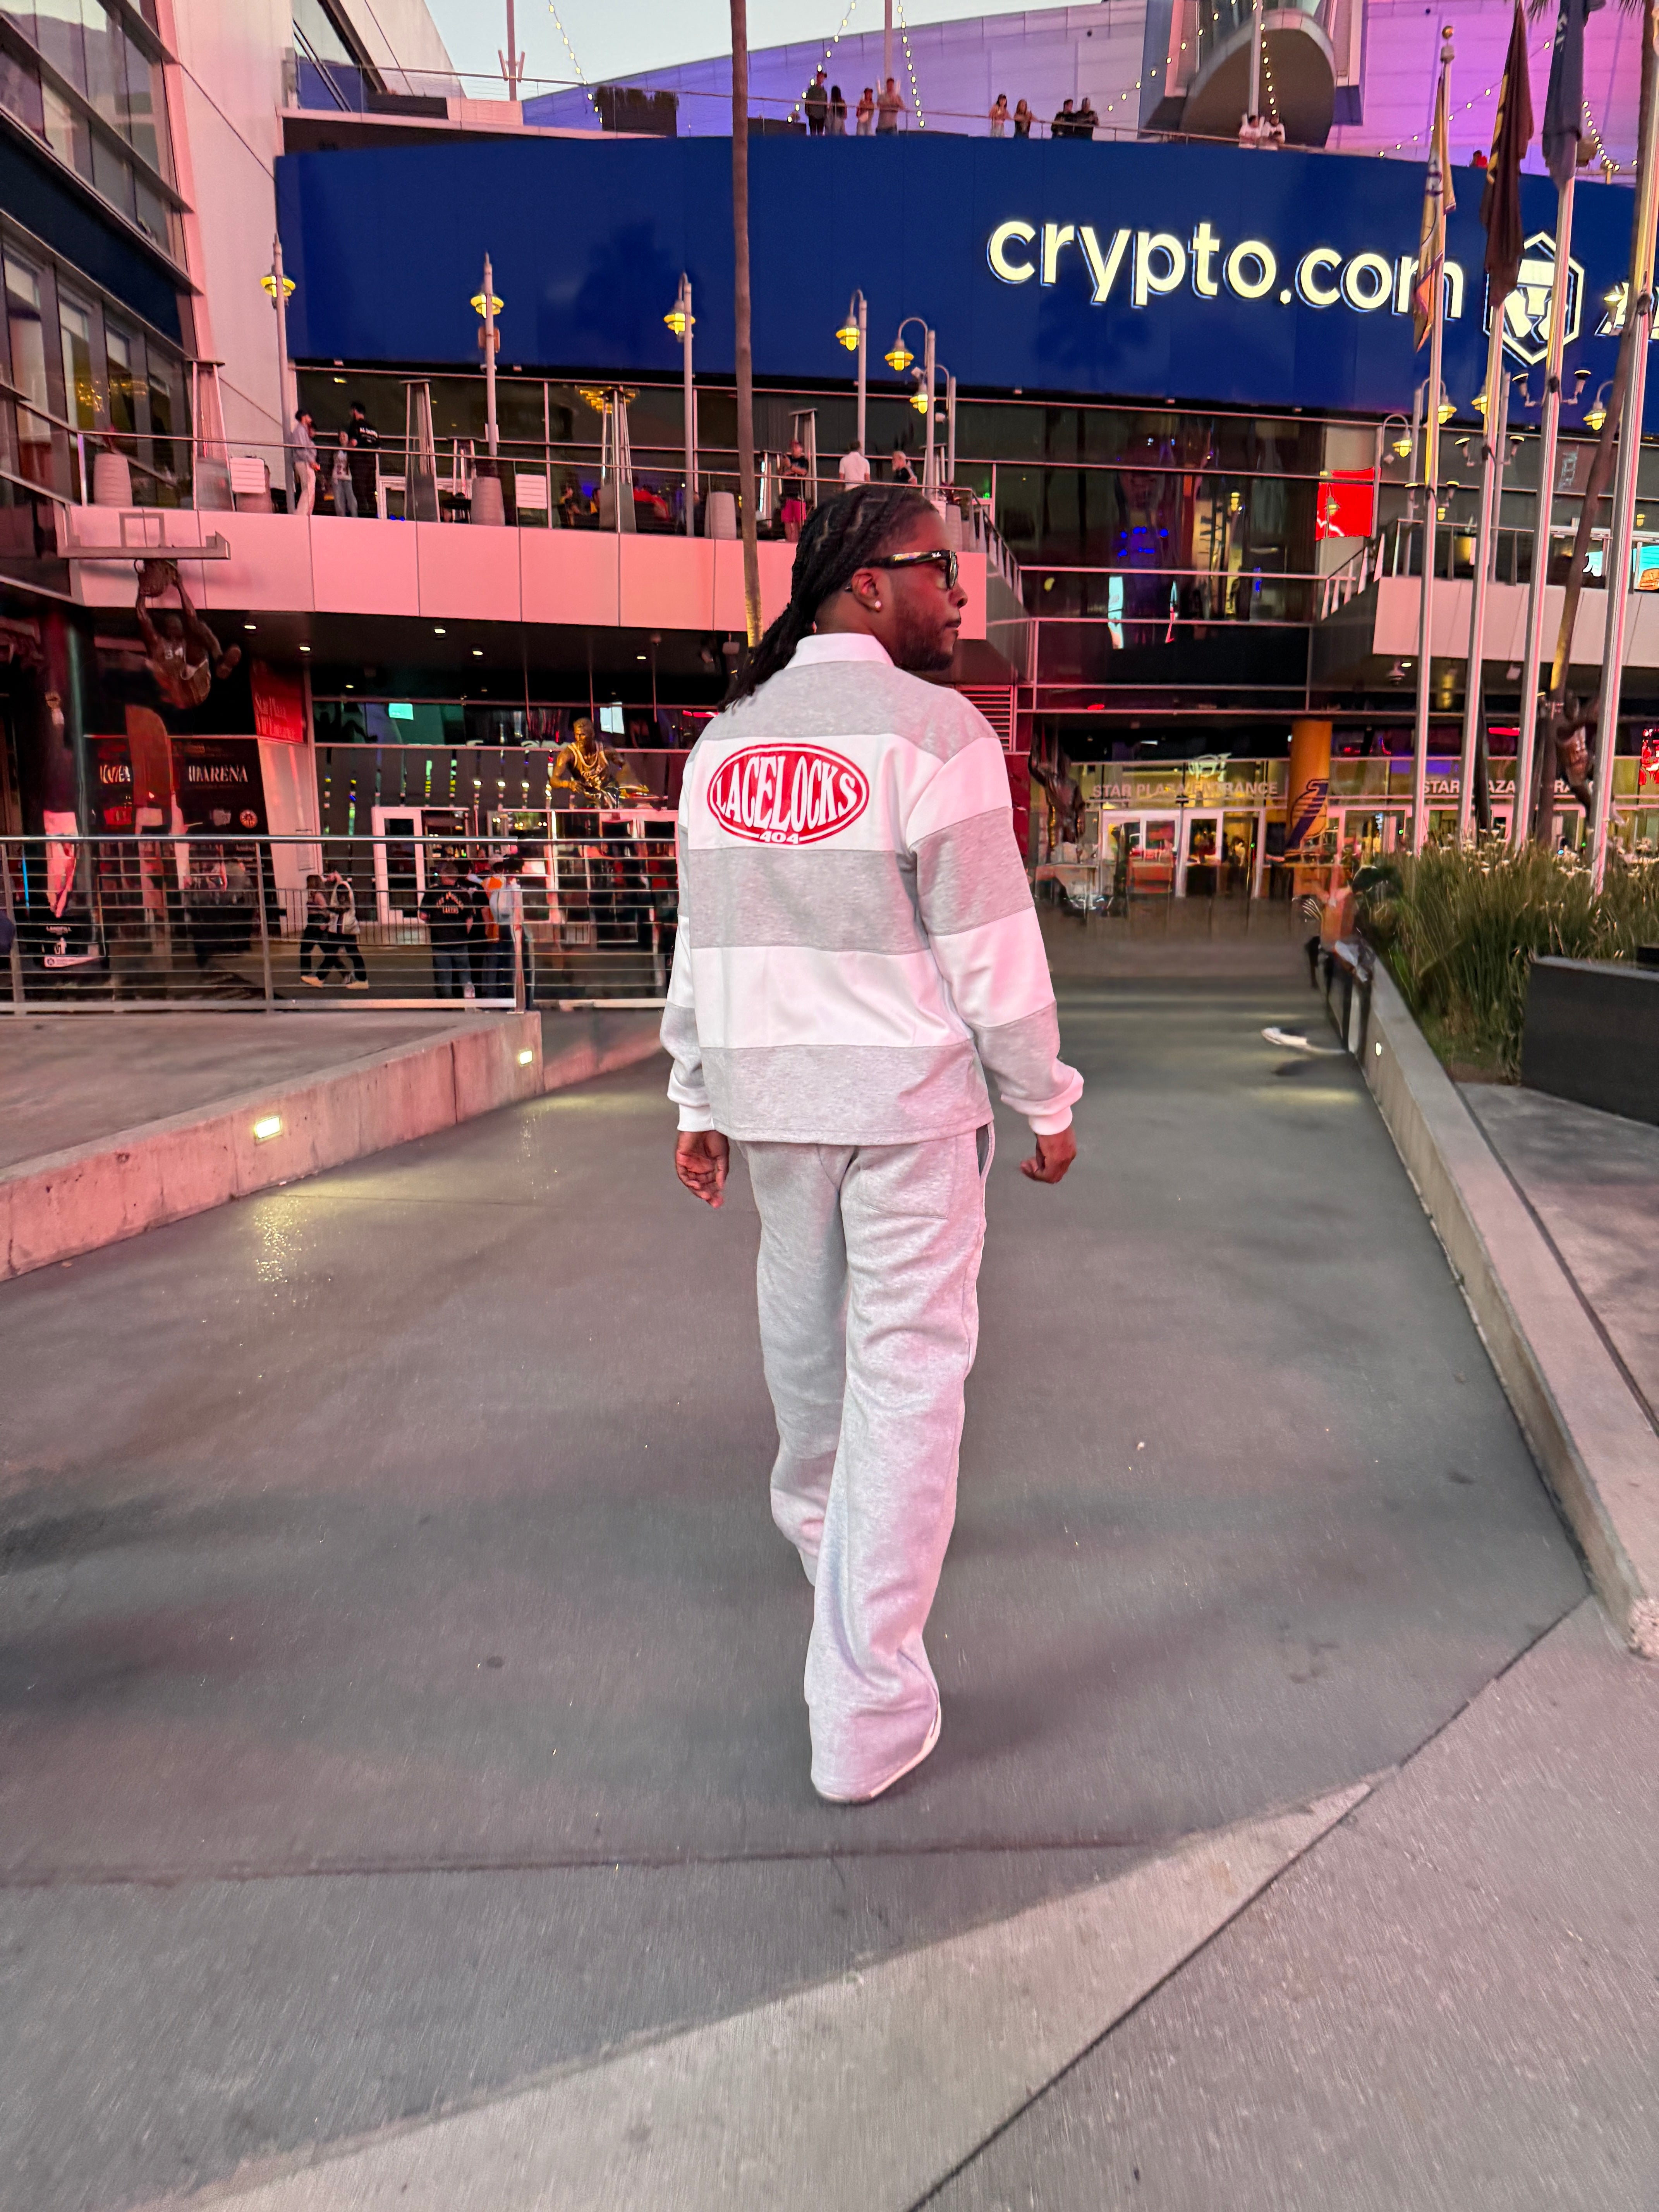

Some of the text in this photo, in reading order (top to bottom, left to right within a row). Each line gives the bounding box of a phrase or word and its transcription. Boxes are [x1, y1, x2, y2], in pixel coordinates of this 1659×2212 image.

[987, 221, 1464, 320] crypto.com
[716, 755, 857, 833] LACELOCKS
[1092, 783, 1132, 797] STAR
[759, 831, 799, 844] 404
